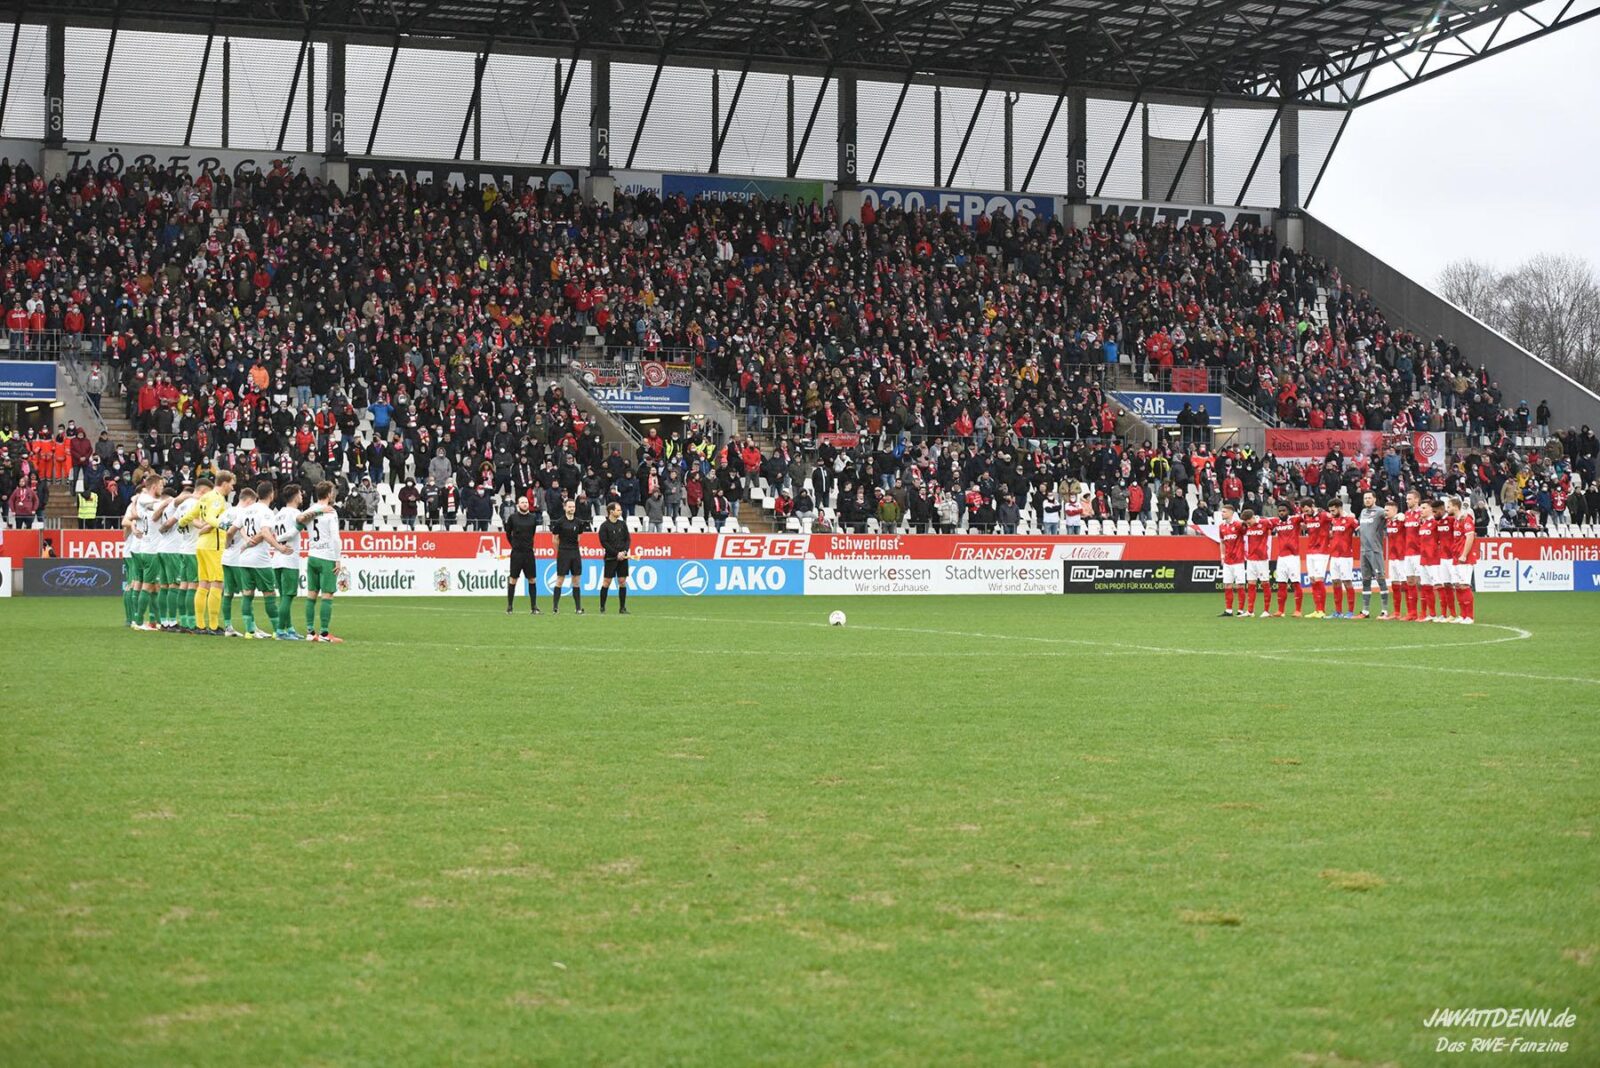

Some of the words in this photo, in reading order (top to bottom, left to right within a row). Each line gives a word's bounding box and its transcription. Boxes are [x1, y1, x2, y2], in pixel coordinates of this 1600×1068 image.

[50, 97, 62, 112] R
[50, 115, 61, 131] 3
[332, 112, 343, 128] R
[332, 130, 343, 145] 4
[597, 128, 609, 143] R
[598, 145, 608, 160] 4
[845, 143, 856, 158] R
[846, 160, 856, 175] 5
[1076, 159, 1086, 173] R
[1076, 175, 1086, 189] 5
[1133, 397, 1165, 414] SAR
[244, 517, 257, 537] 23
[313, 518, 320, 542] 5
[360, 534, 417, 550] GmbH
[831, 535, 904, 550] Schwerlast-
[635, 546, 671, 557] GmbH
[959, 547, 1047, 560] TRANSPORTE
[1540, 545, 1600, 561] Mobilitä
[55, 568, 98, 587] Ford
[715, 565, 787, 591] JAKO
[809, 564, 931, 580] Stadtwerkessen
[945, 564, 1060, 580] Stadtwerkessen
[1071, 565, 1176, 582] mybanner.de
[1483, 565, 1512, 578] e3e
[1539, 570, 1570, 581] Allbau
[358, 568, 415, 592] Stauder
[855, 583, 870, 592] Wir
[872, 582, 890, 592] sind
[988, 583, 1002, 592] Wir
[1004, 582, 1022, 592] sind
[1095, 582, 1109, 590] DEIN
[1109, 582, 1126, 590] PROFI
